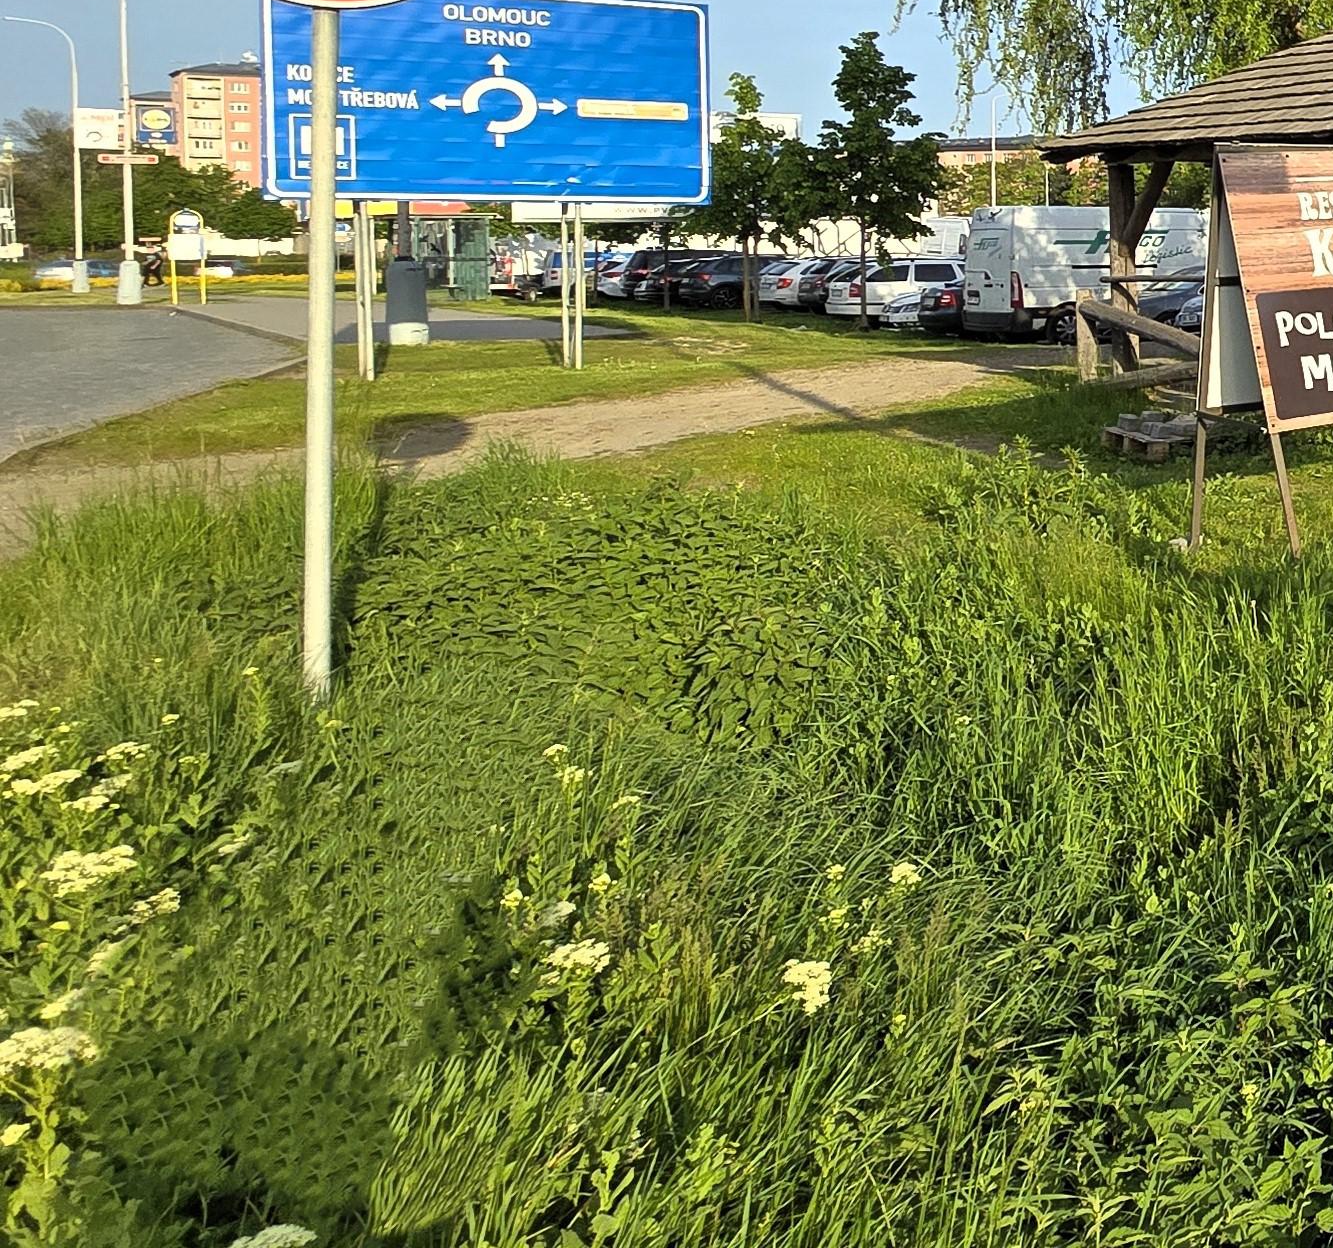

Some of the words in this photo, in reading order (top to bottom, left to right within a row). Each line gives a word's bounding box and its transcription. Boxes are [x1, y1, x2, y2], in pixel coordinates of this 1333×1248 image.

[443, 4, 551, 27] OLOMOUC
[465, 28, 531, 48] BRNO
[339, 87, 419, 110] TŘEBOVÁ
